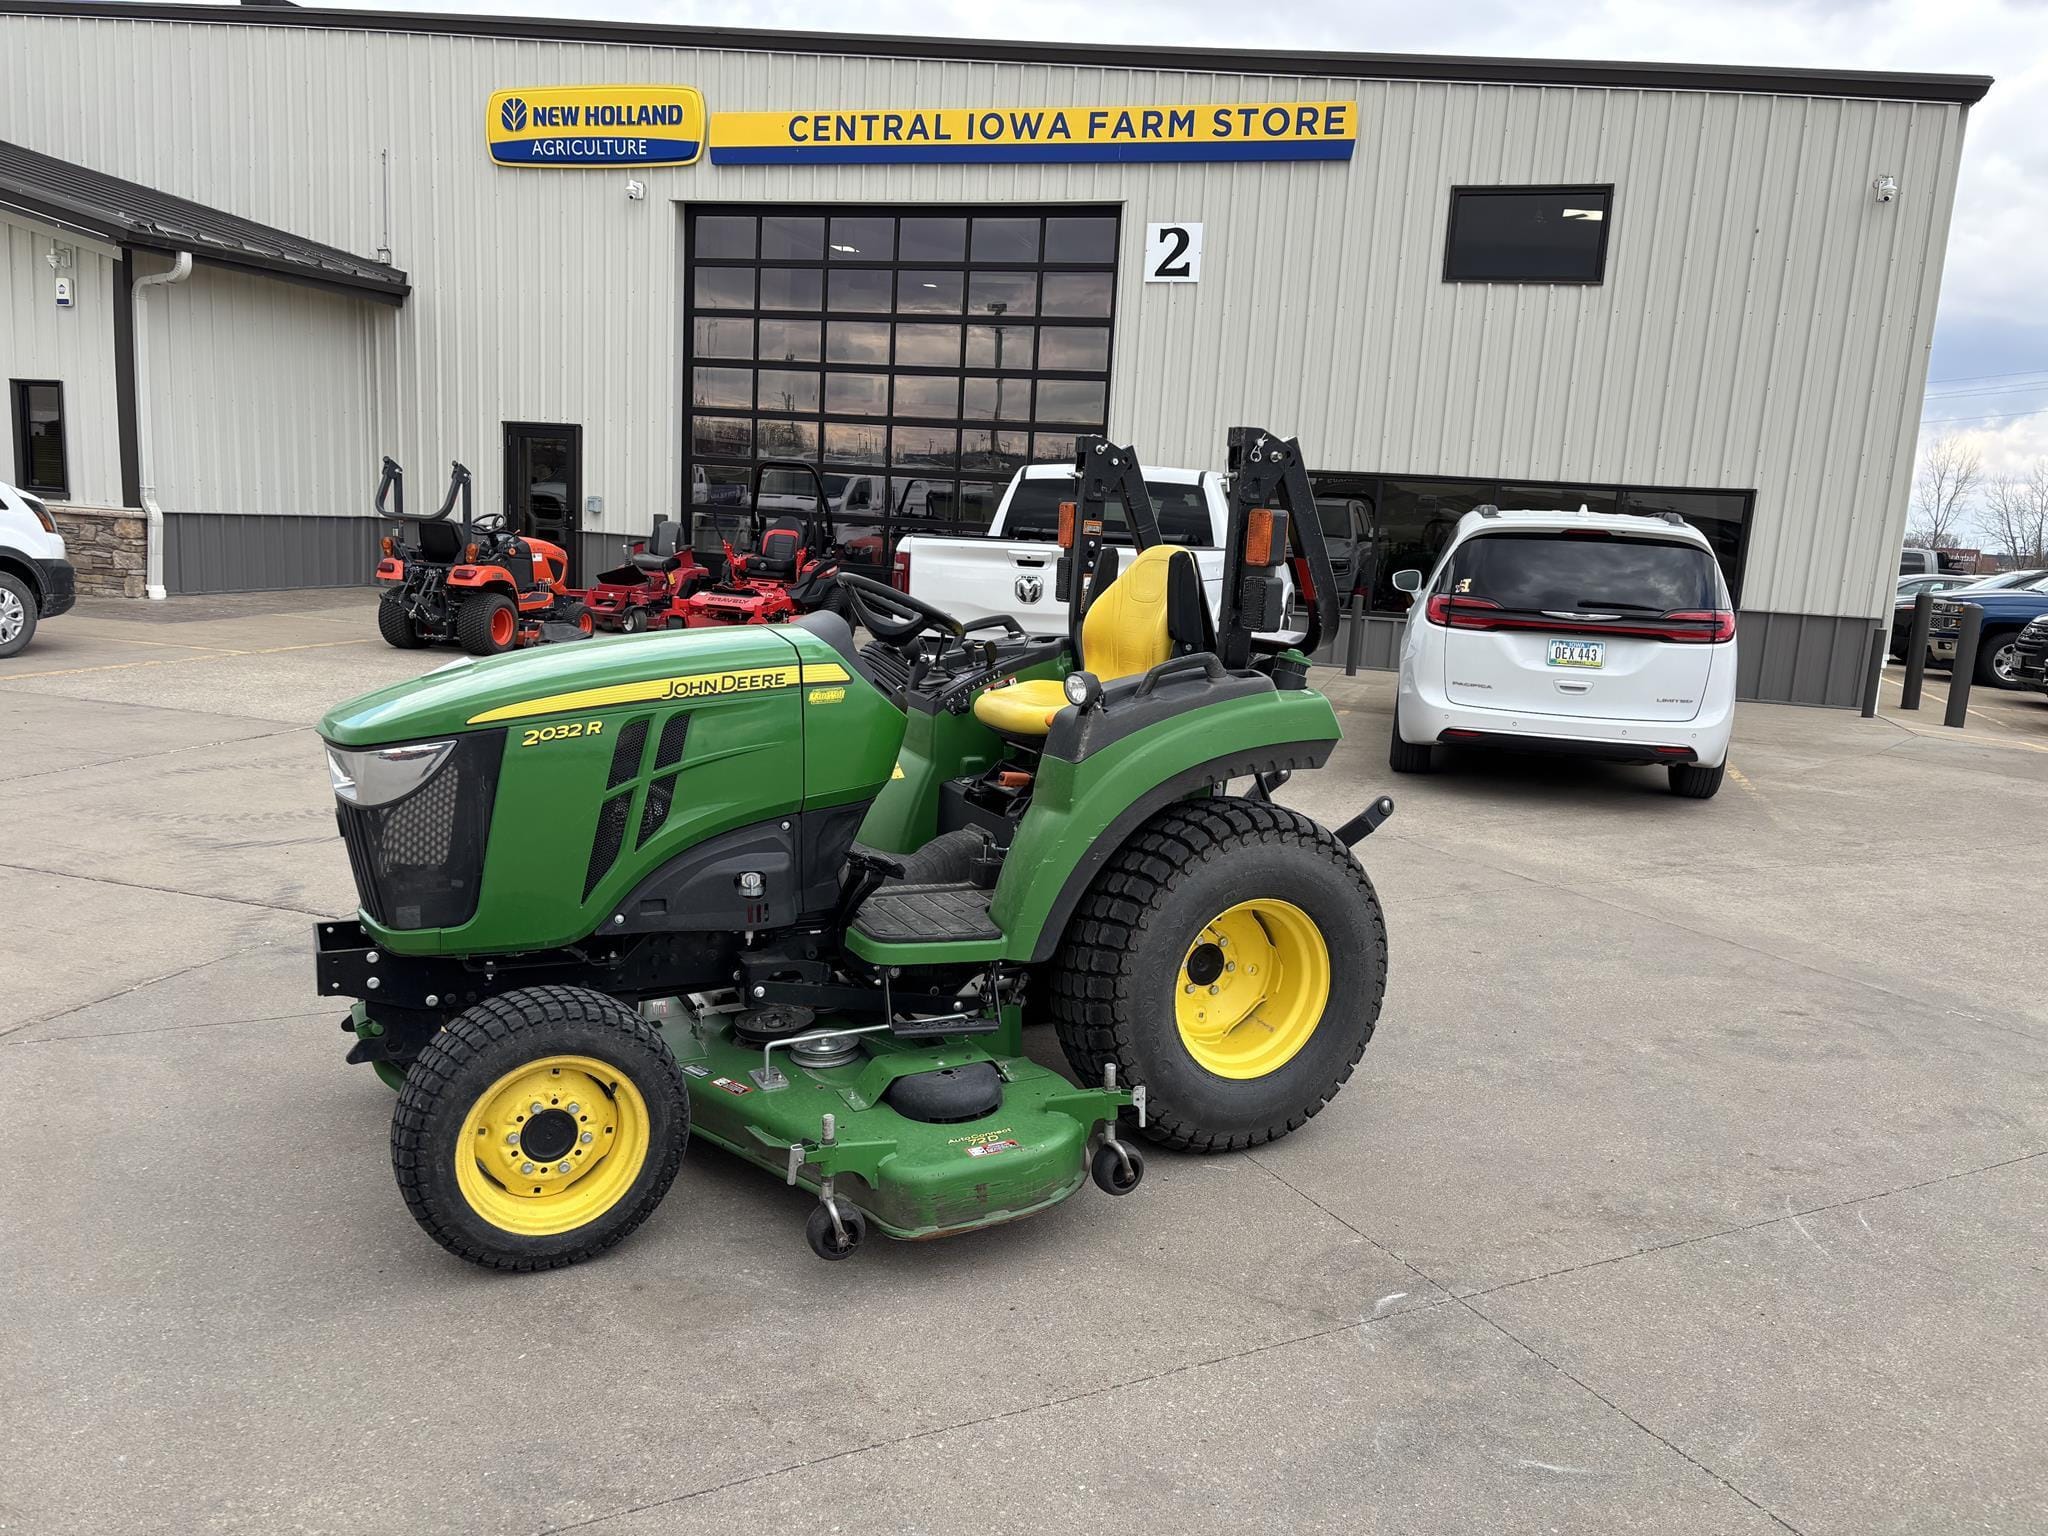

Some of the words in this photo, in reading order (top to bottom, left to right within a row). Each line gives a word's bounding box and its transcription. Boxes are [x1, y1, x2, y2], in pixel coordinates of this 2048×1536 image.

[533, 106, 580, 127] NEW
[585, 104, 684, 126] HOLLAND
[788, 113, 952, 142] CENTRAL
[967, 112, 1072, 140] IOWA
[1088, 109, 1196, 139] FARM
[1212, 106, 1347, 137] STORE
[532, 139, 648, 156] AGRICULTURE
[1154, 227, 1190, 277] 2
[1578, 648, 1597, 661] 443
[662, 679, 718, 698] JOHN
[721, 673, 786, 691] DEERE
[1452, 681, 1493, 689] PACIFICA
[522, 723, 583, 746] 2032
[947, 1127, 1013, 1145] AutoConnect
